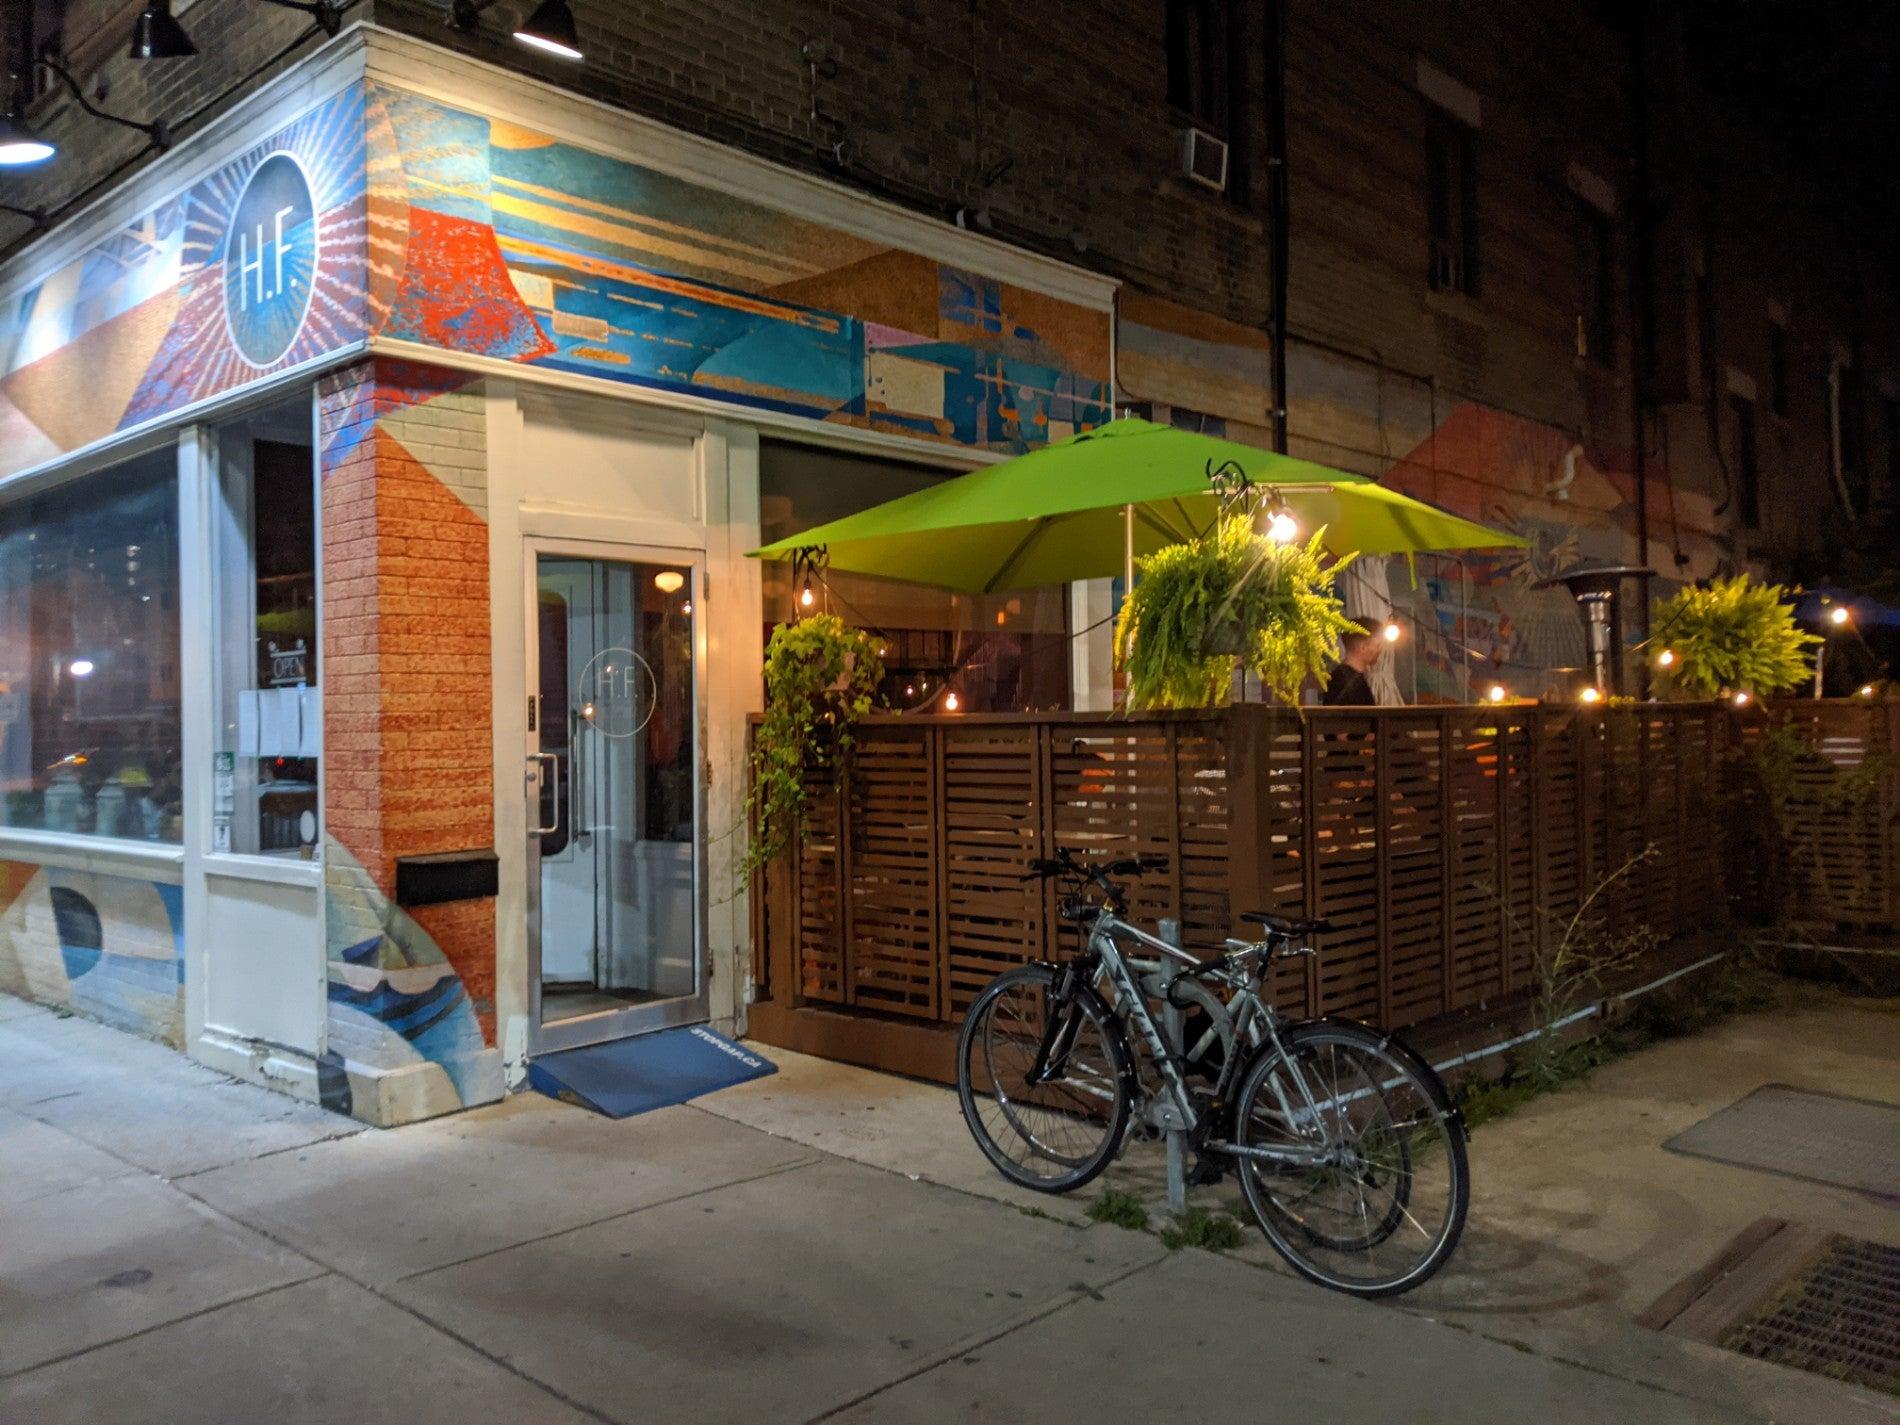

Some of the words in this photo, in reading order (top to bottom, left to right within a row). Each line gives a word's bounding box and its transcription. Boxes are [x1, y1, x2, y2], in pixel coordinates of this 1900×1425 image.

[240, 205, 298, 312] H.F.
[273, 656, 306, 679] OPEN
[597, 666, 638, 698] H.F.
